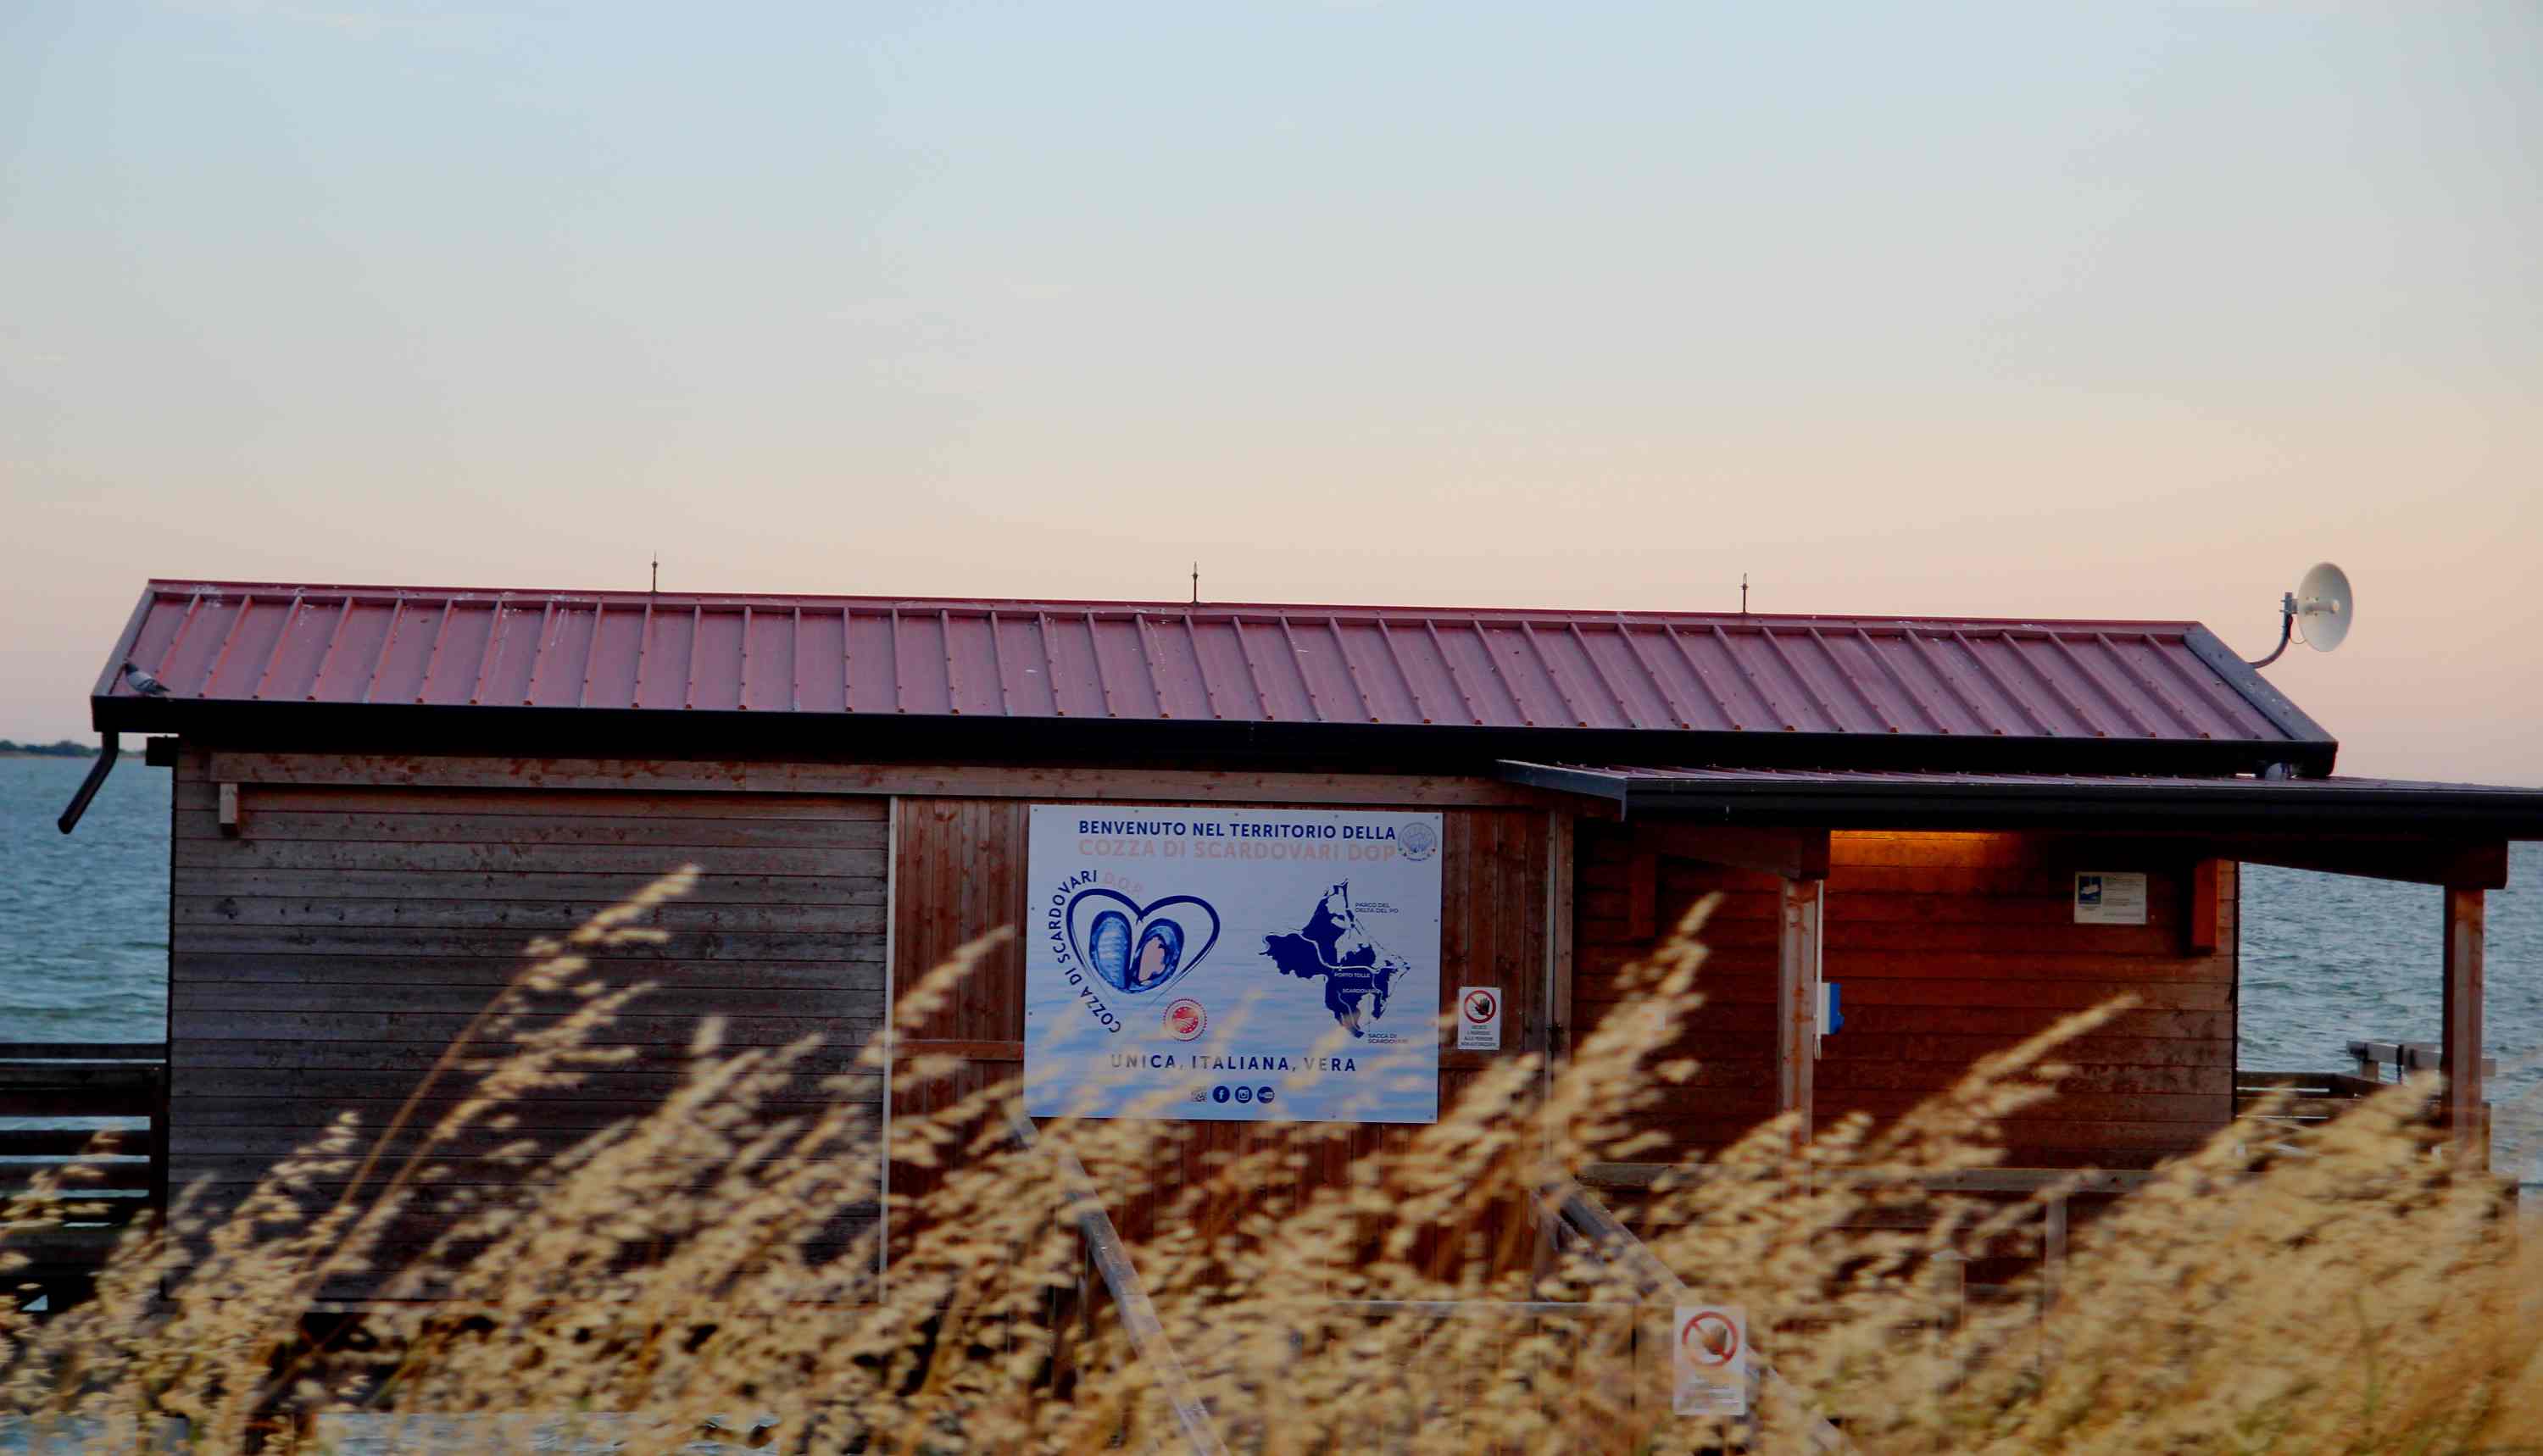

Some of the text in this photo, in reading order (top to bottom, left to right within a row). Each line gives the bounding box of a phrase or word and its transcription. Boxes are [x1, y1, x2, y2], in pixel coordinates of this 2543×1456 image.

[1079, 820, 1396, 840] BENVENUTO NEL TERRITORIO DELLA
[1078, 839, 1396, 861] COZZA DI SCARDOVARI DOP
[1049, 870, 1097, 964] SCARDOVARI
[1065, 968, 1082, 986] DI
[1080, 986, 1121, 1033] COZZA
[1303, 1057, 1356, 1072] VERA
